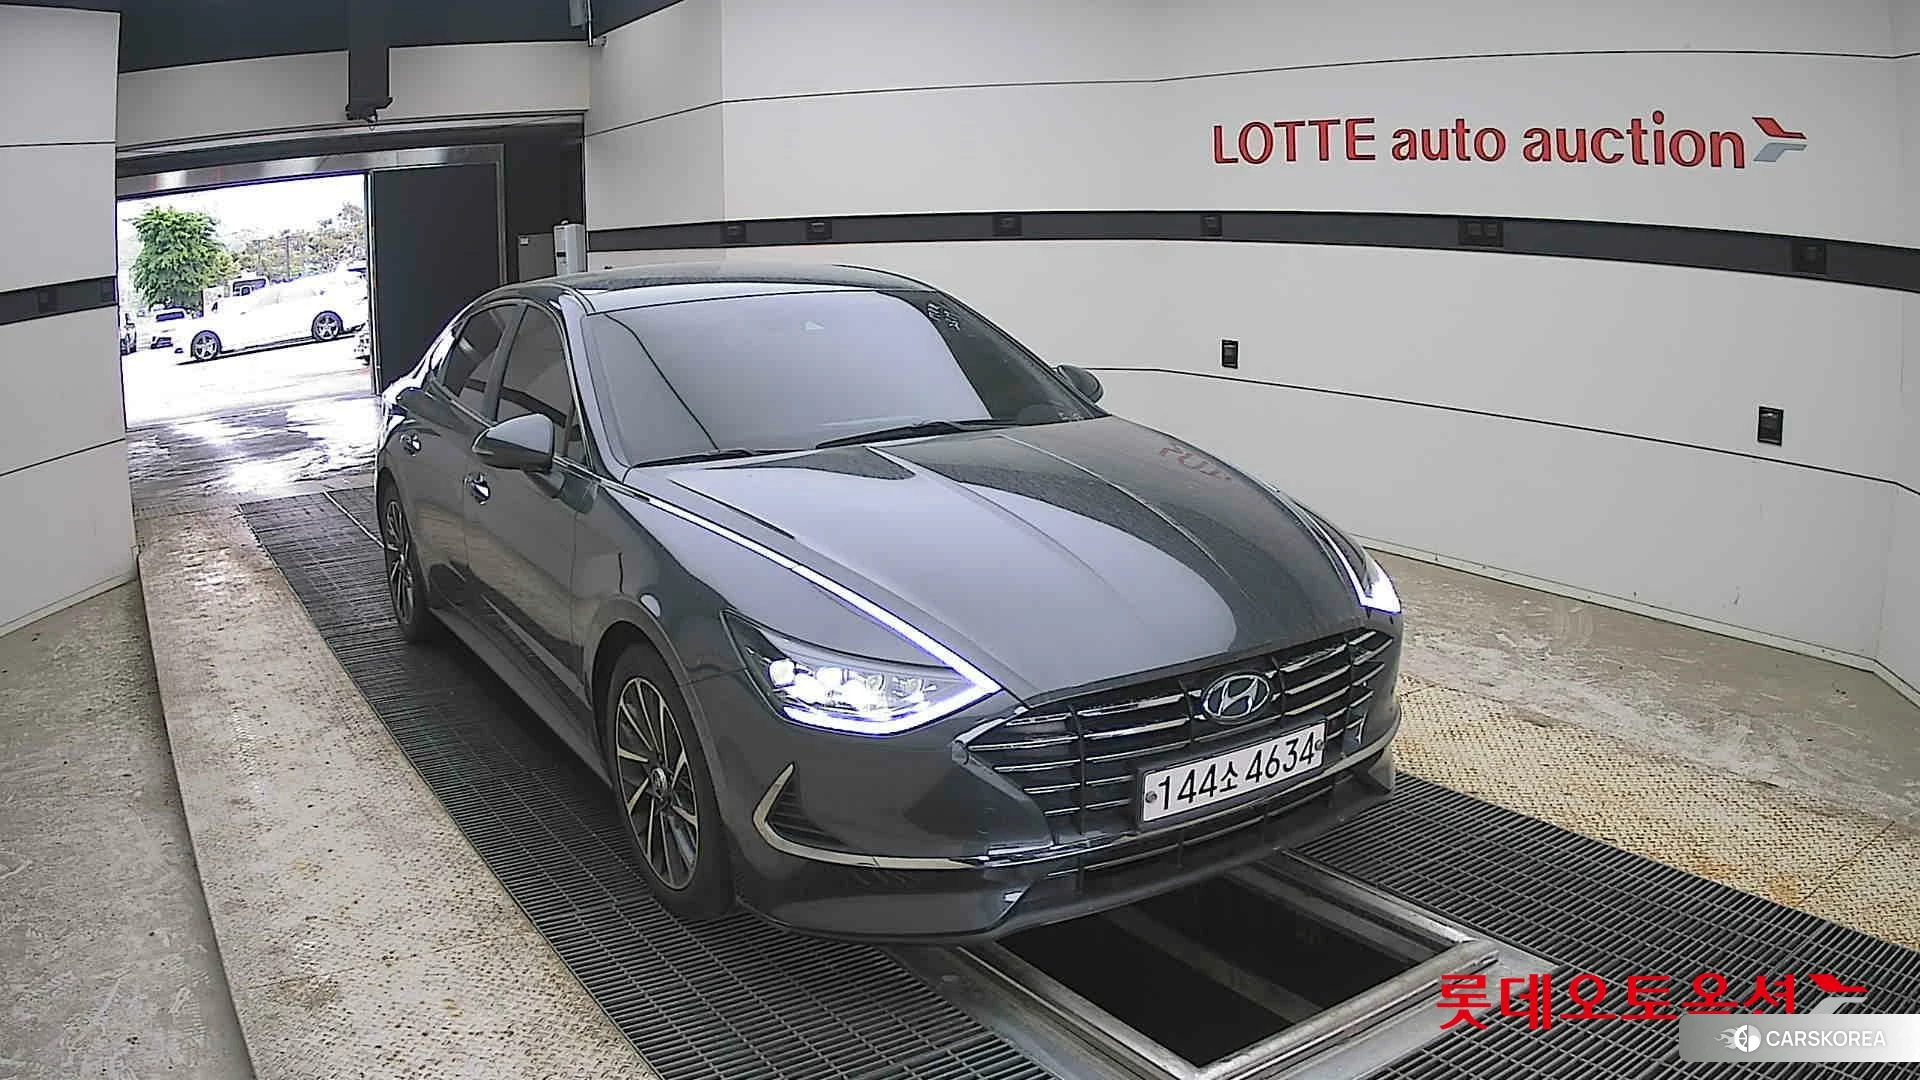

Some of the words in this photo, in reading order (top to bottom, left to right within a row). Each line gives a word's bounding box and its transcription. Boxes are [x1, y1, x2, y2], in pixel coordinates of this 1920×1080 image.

[1213, 117, 1376, 164] LOTTE
[1391, 118, 1506, 162] auto
[1522, 110, 1745, 168] auction
[1158, 761, 1239, 811] 144소
[1245, 731, 1315, 784] 4634
